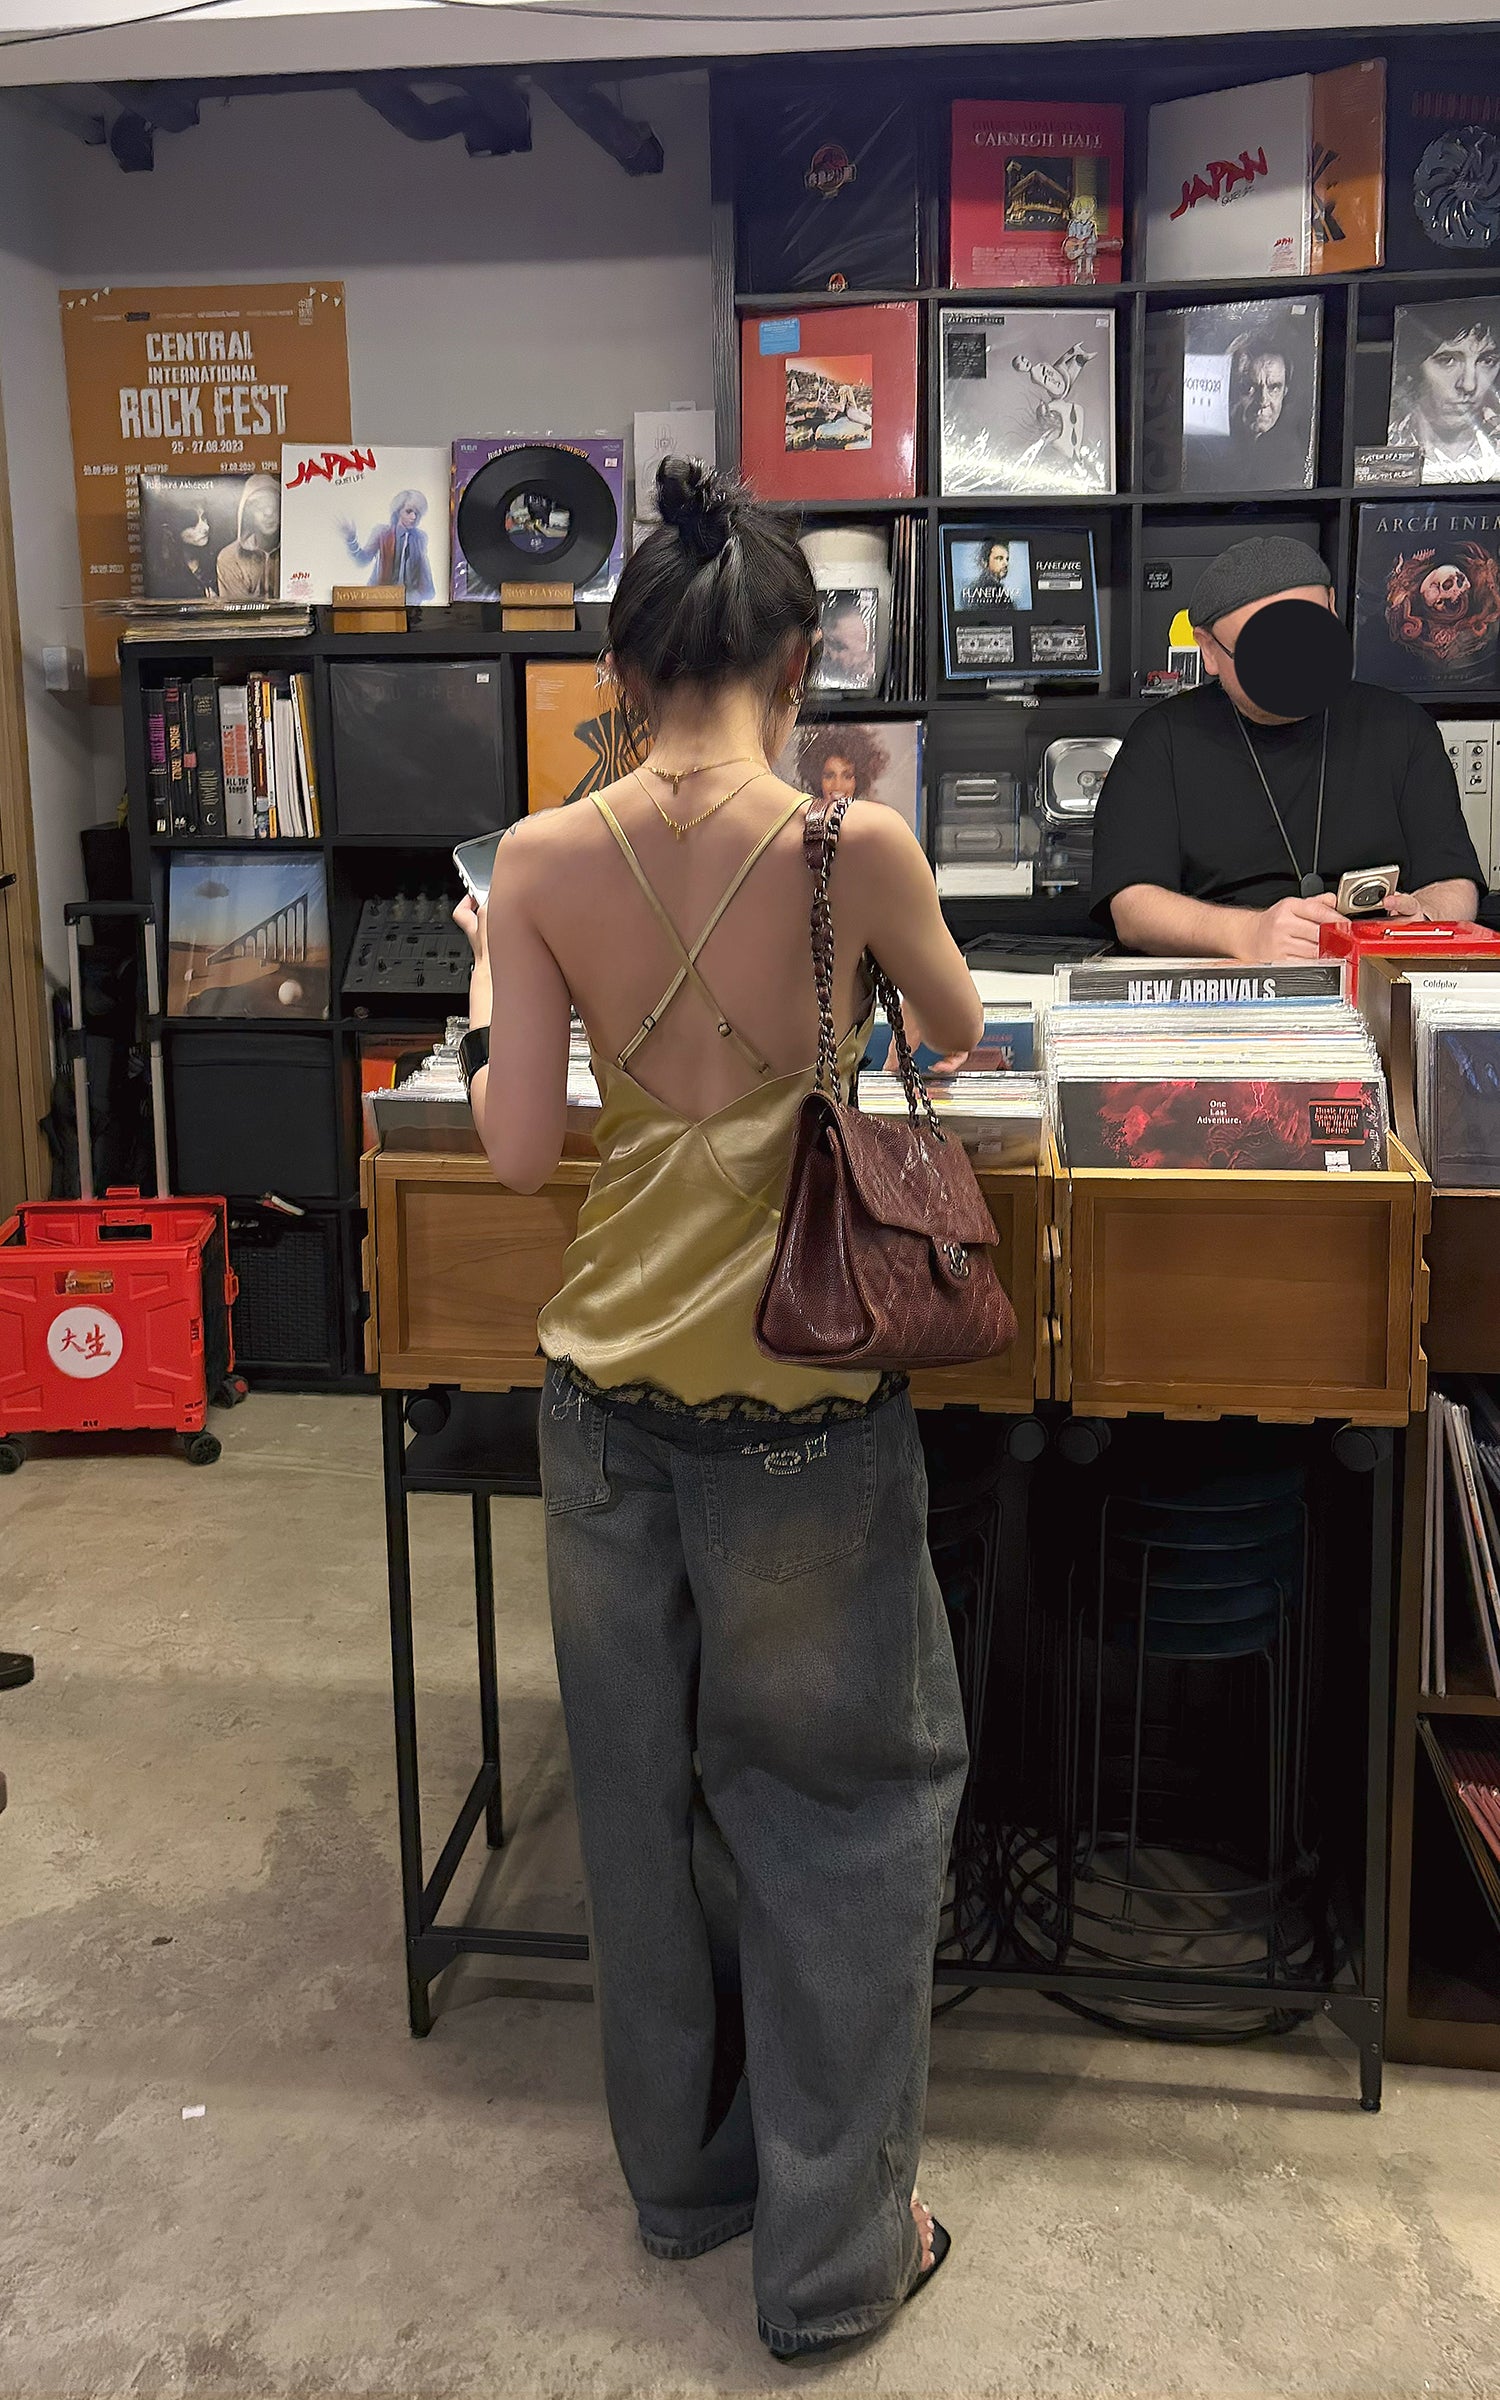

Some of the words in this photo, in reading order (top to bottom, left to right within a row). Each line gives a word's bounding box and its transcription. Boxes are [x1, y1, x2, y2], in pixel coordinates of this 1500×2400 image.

[1170, 146, 1268, 221] JAPAN
[146, 331, 253, 362] CENTRAL
[148, 365, 258, 385] INTERNATIONAL
[119, 386, 203, 439] ROCK
[214, 384, 288, 437] FEST
[285, 448, 377, 489] JAPAN
[1376, 515, 1439, 533] ARCH
[1127, 979, 1173, 1003] NEW
[1178, 978, 1277, 1003] ARRIVALS
[1423, 979, 1458, 990] Coldplay
[1209, 1100, 1227, 1108] One
[1209, 1108, 1228, 1116] Last
[1196, 1116, 1243, 1124] Adventure.
[60, 1323, 111, 1361] 大生
